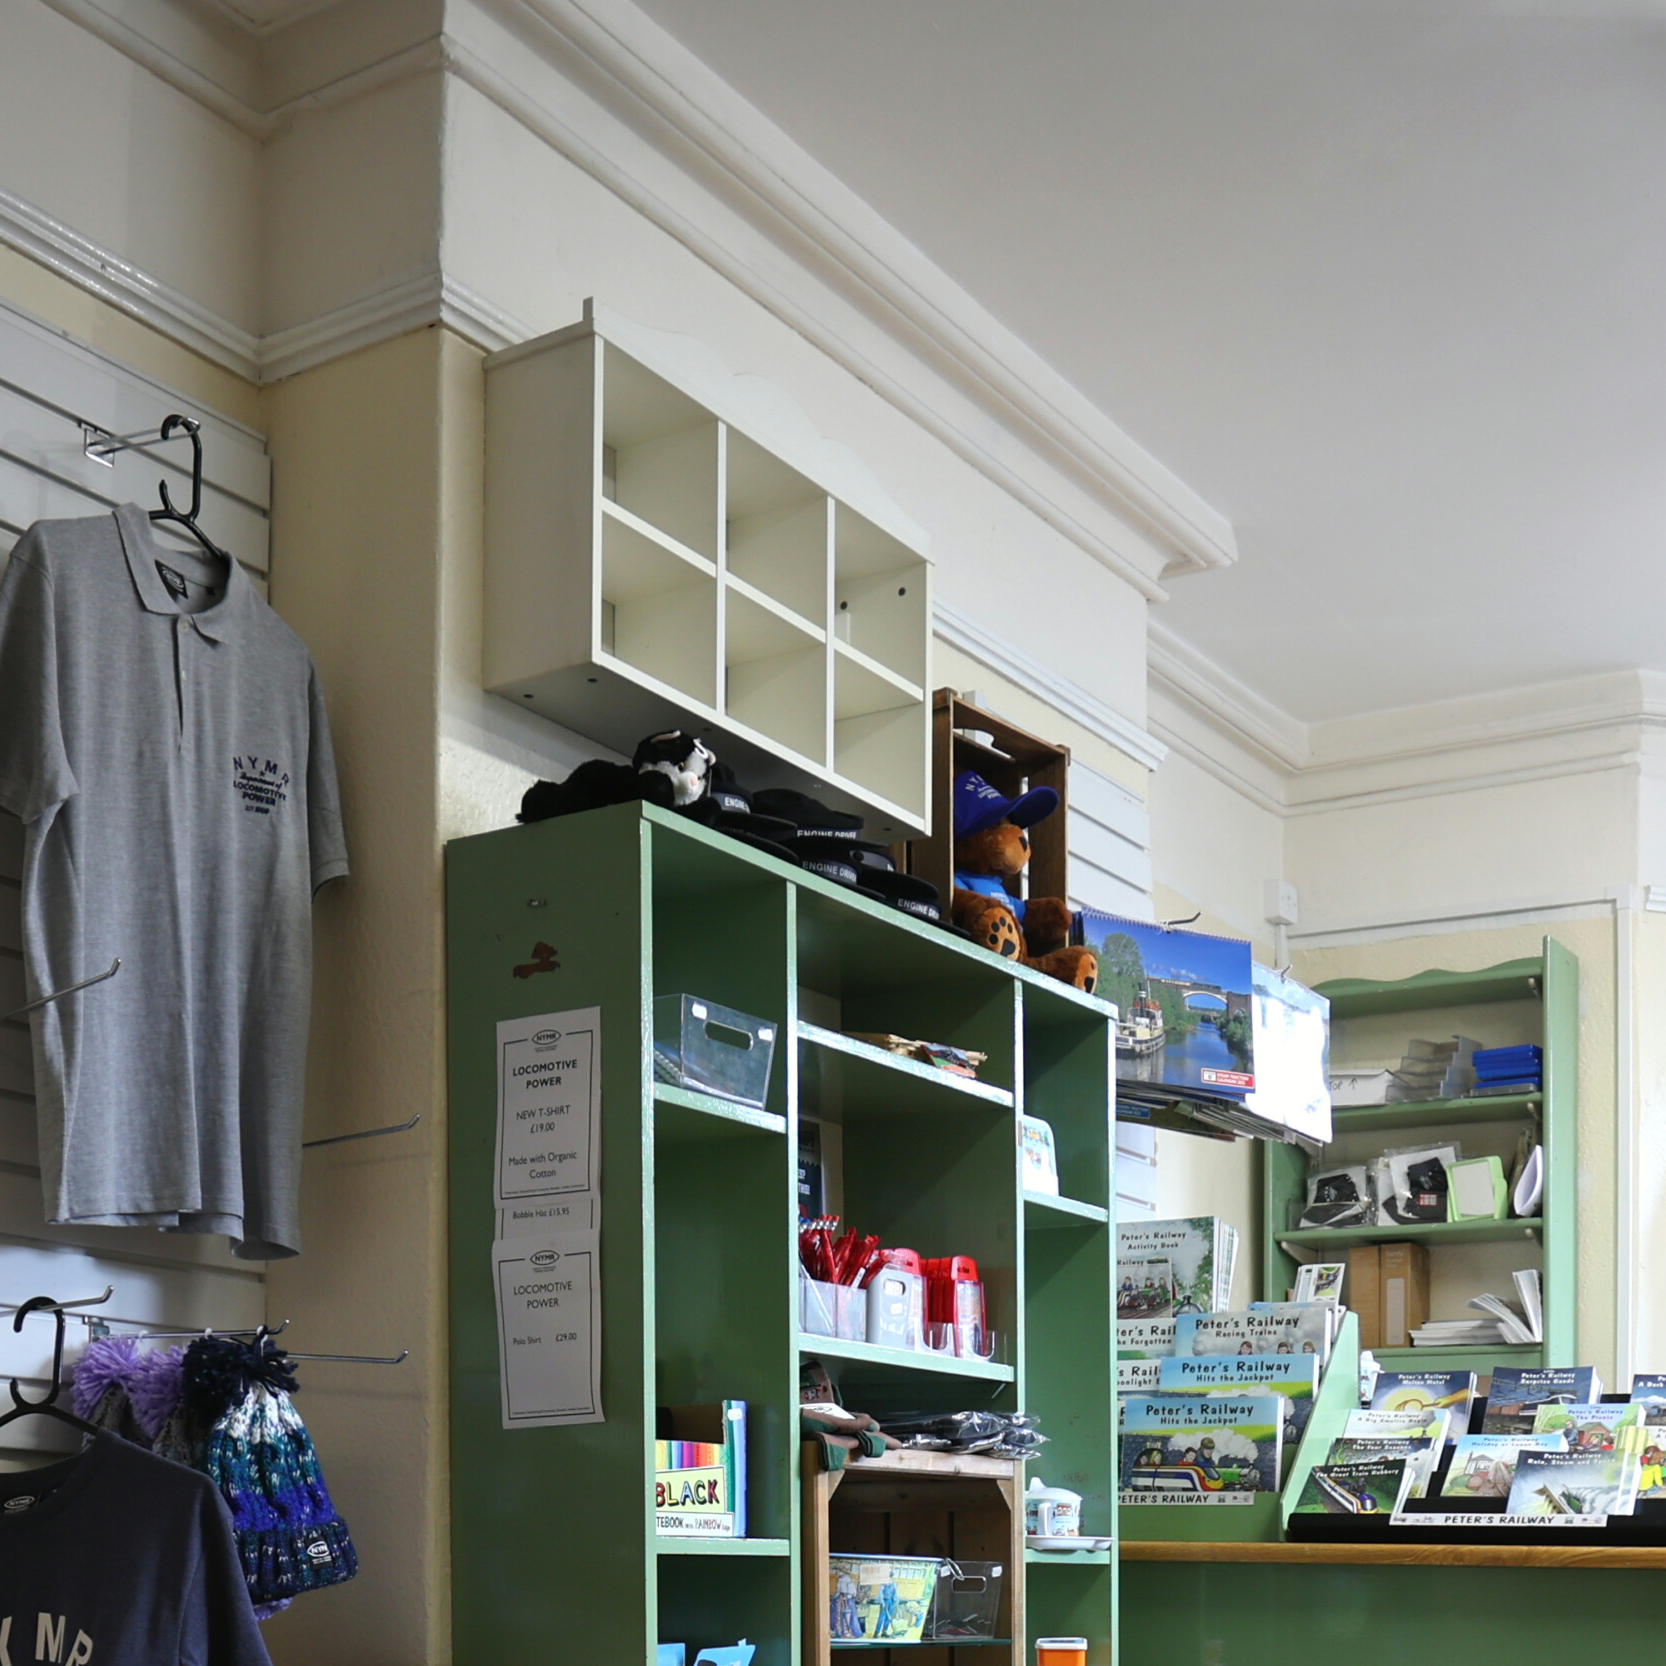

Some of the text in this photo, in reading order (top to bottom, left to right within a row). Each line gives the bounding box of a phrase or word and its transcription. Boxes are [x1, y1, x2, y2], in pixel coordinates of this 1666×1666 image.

[233, 755, 289, 787] NYMR
[233, 780, 286, 800] LOCOMOTIVE
[242, 791, 276, 806] POWER
[724, 796, 745, 810] ENGINE
[802, 860, 838, 875] ENGINE
[897, 898, 929, 915] ENGINE
[536, 1033, 556, 1042] NYMR
[513, 1060, 577, 1076] LOCOMOTIVE
[526, 1076, 562, 1089] POWER
[516, 1104, 571, 1121] NEW T-SHIRT
[530, 1122, 555, 1134] £19.00
[508, 1151, 577, 1166] Made with Organic
[529, 1169, 556, 1180] Cotton
[513, 1206, 570, 1220] Bobble Hat £15.95
[1121, 1231, 1187, 1241] Peter's Railway
[1127, 1241, 1179, 1250] Activity Book
[535, 1253, 555, 1262] NYMR
[1117, 1258, 1144, 1267] Railway
[513, 1281, 573, 1296] LOCOMOTIVE
[527, 1298, 559, 1310] POWER
[1195, 1315, 1300, 1330] Peter's Railway
[513, 1332, 577, 1345] Polo Shirt £29.00
[1215, 1328, 1278, 1338] Racing Trains
[1130, 1336, 1172, 1347] Forgotten
[1182, 1361, 1290, 1374] Peter's Railway
[1196, 1373, 1274, 1383] Hits the Jackpot
[1146, 1403, 1254, 1417] Peter's Railway
[1160, 1417, 1238, 1426] Hits the Jackpot
[1571, 1452, 1602, 1460] Railway
[1333, 1463, 1385, 1473] Peter's Railway
[1371, 1468, 1400, 1476] Robbery
[656, 1479, 721, 1508] BLACK
[1118, 1494, 1210, 1504] PETER'S RAILWAY
[656, 1516, 721, 1530] TEBOOK RAINBOW
[1444, 1515, 1555, 1525] PETER'S RAILWAY
